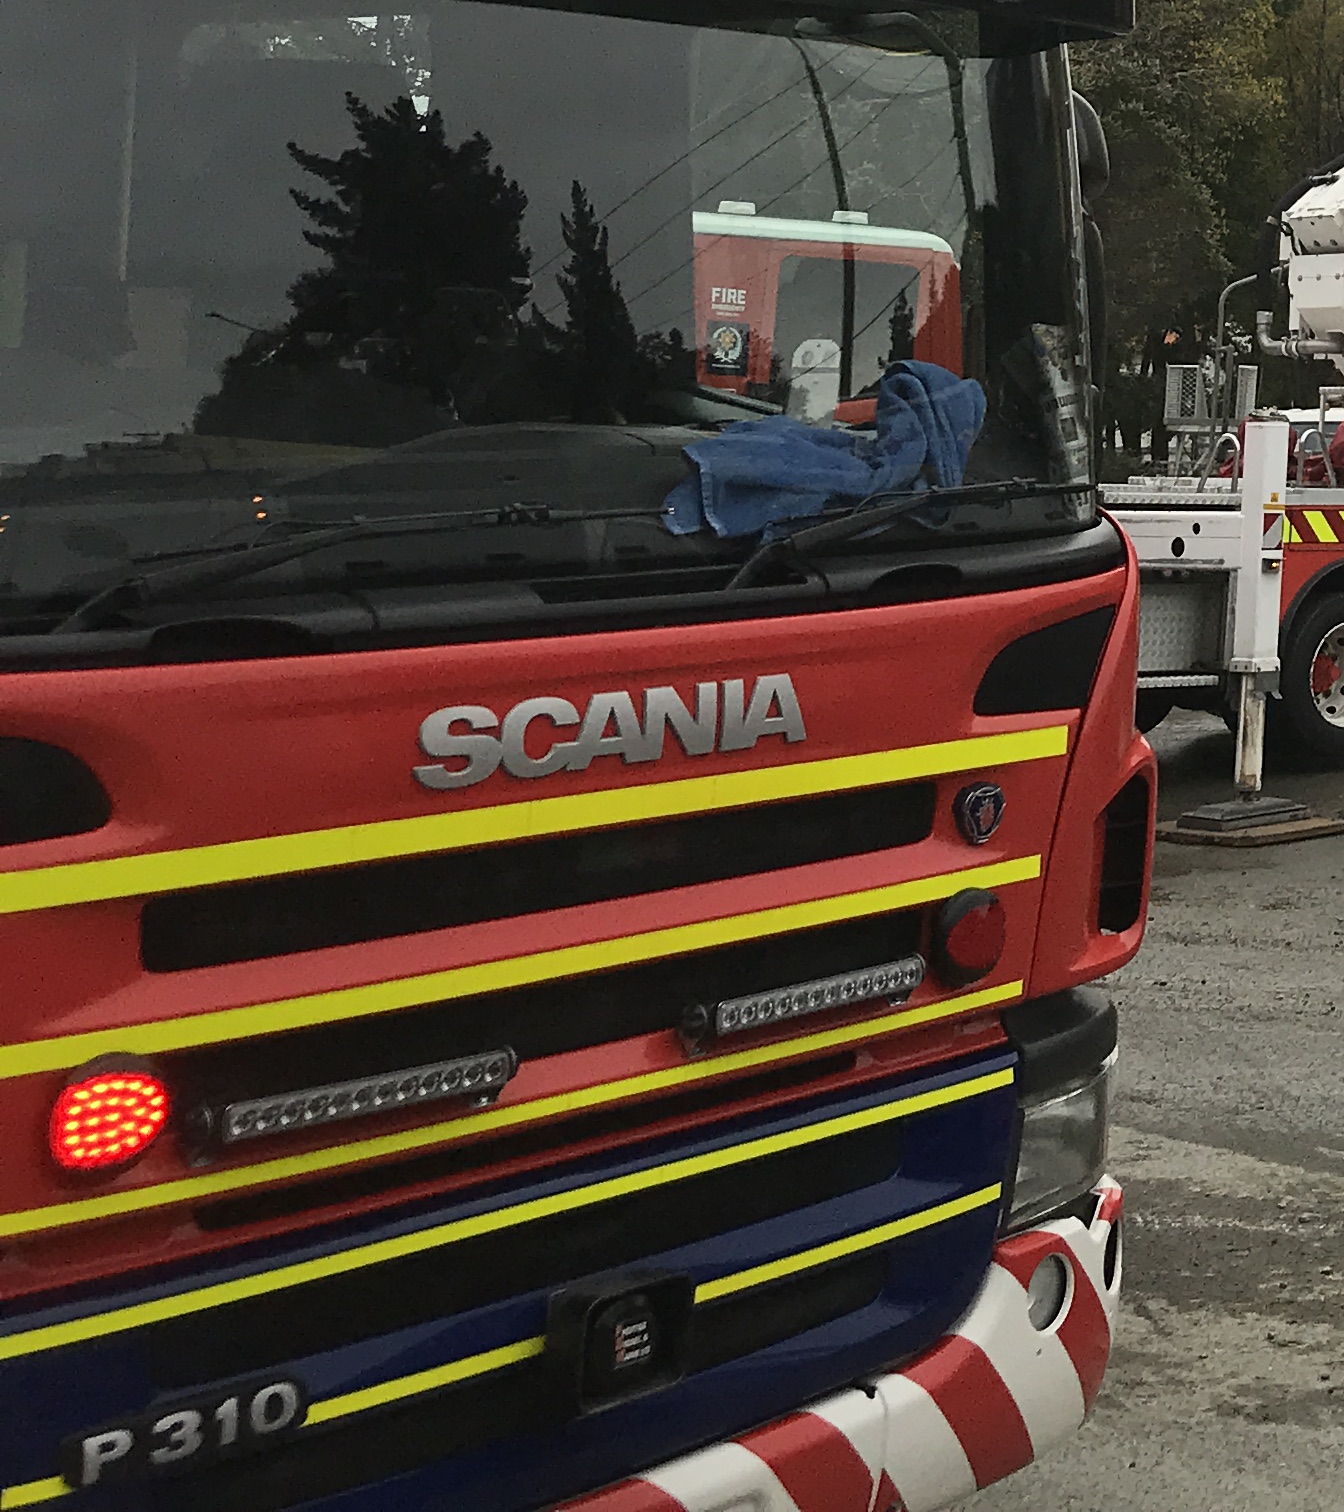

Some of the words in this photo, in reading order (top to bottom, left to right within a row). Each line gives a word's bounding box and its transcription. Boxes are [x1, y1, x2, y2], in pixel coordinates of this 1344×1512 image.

[711, 287, 747, 305] FIRE
[412, 672, 807, 790] SCANIA
[81, 1428, 134, 1486] P
[150, 1381, 299, 1465] 310
